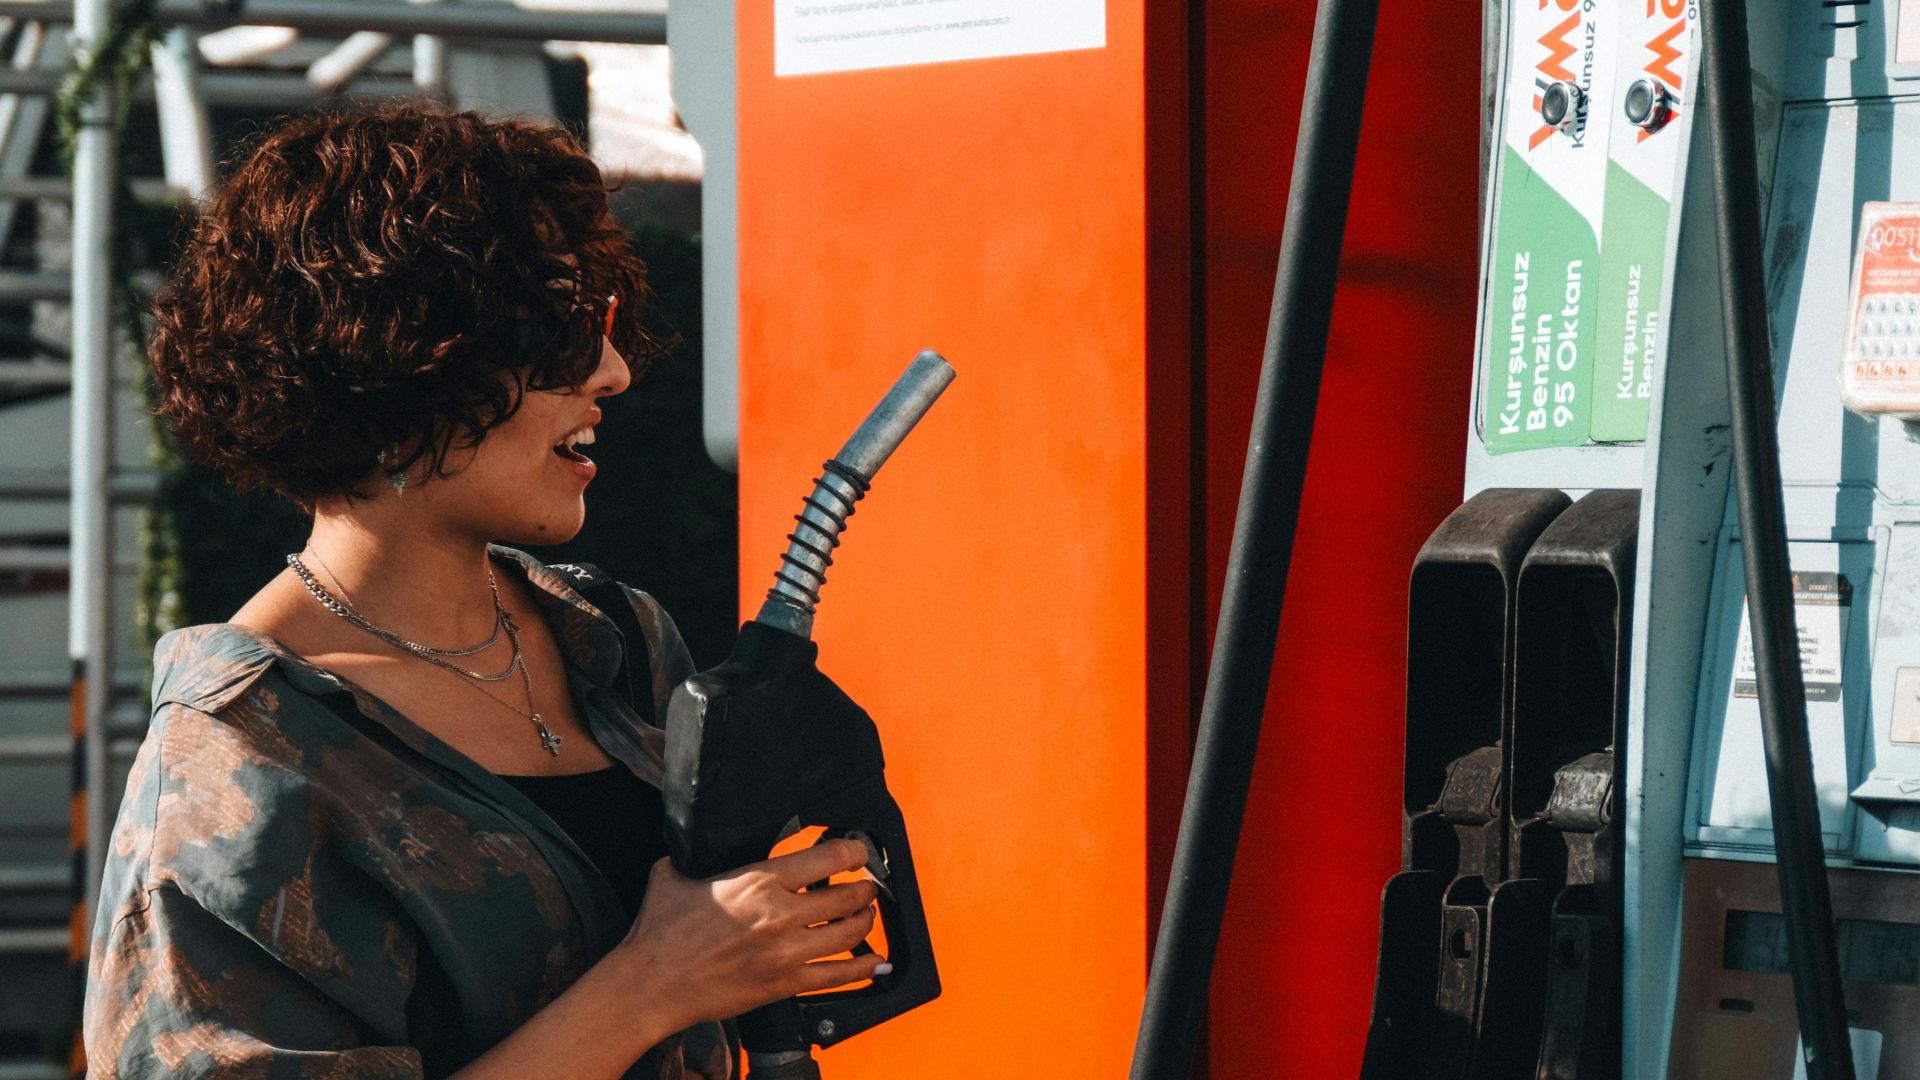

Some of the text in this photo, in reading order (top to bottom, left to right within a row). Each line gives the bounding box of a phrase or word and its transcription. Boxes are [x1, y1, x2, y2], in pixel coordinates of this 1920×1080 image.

[1499, 252, 1530, 435] Kurşunsuz
[1526, 314, 1552, 431] Benzin
[1553, 259, 1582, 428] 95 Oktan
[1616, 264, 1641, 399] Kurşunsuz
[1637, 311, 1658, 398] Benzin
